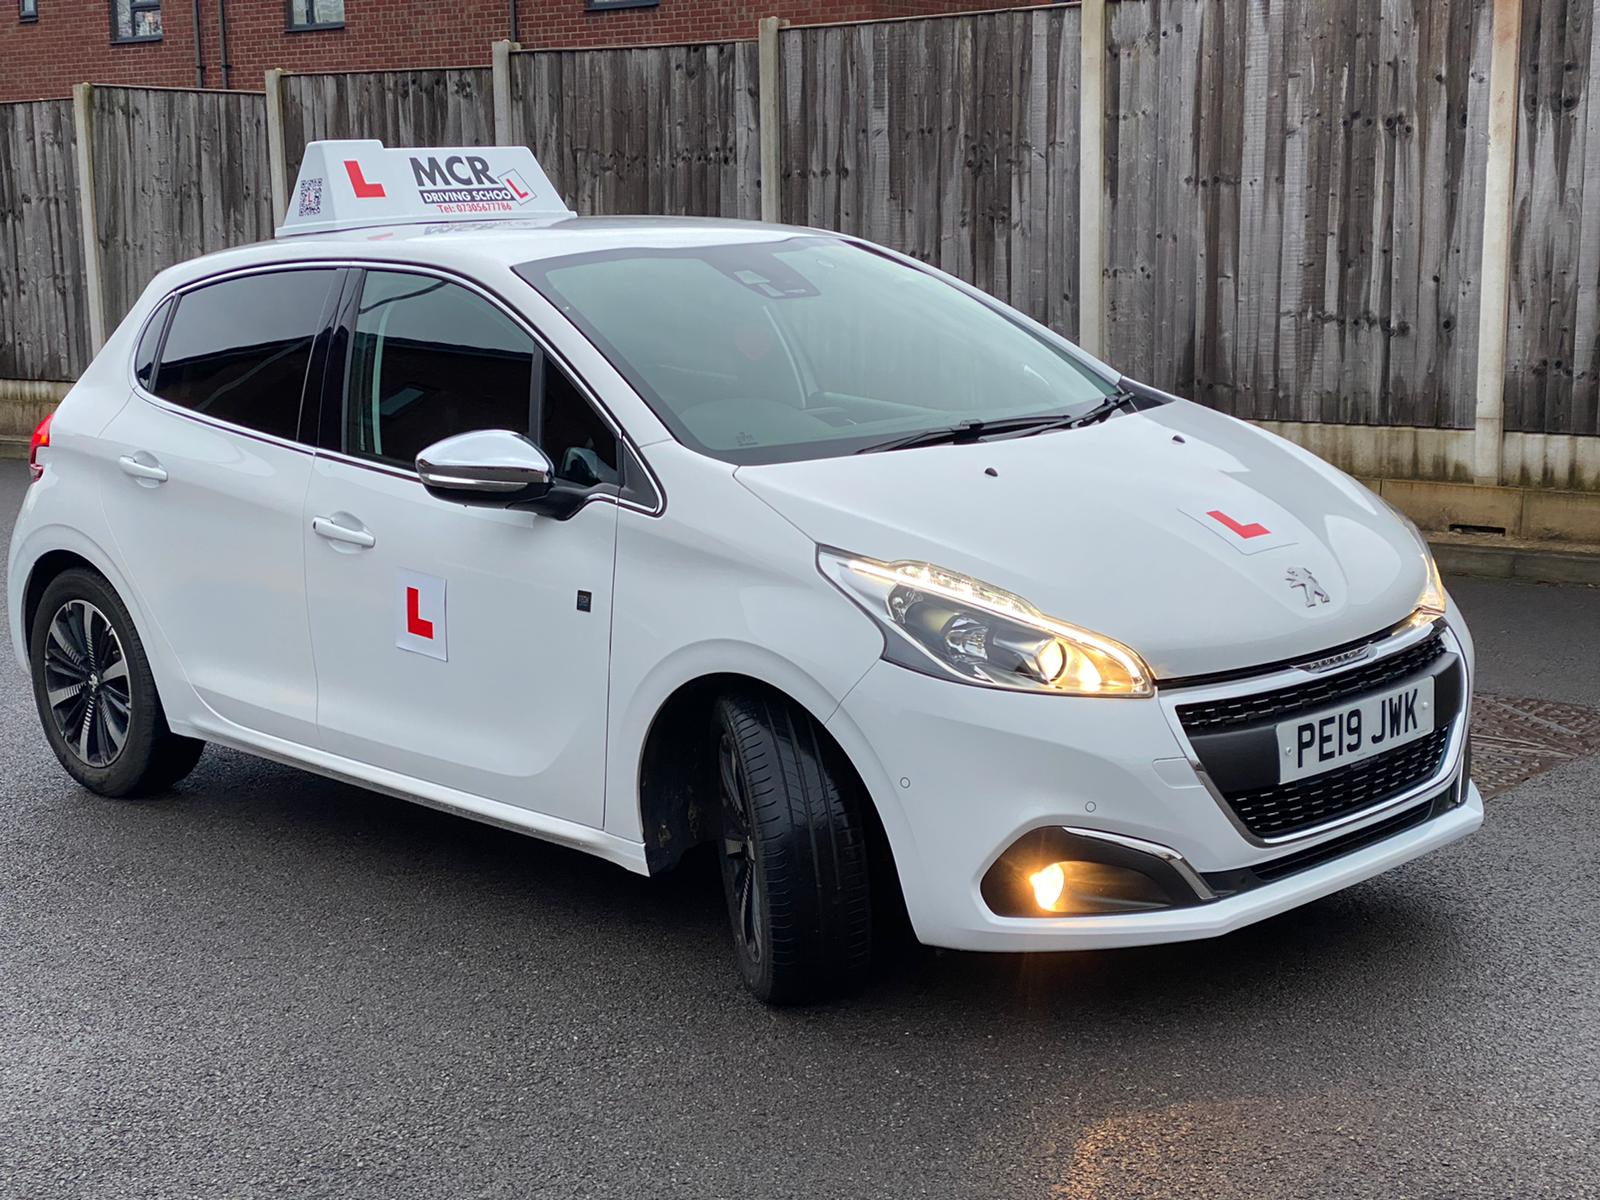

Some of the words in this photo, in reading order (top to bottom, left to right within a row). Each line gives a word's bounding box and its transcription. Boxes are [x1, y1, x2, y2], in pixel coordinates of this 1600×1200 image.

[343, 160, 386, 198] L
[409, 155, 499, 187] MCR
[422, 190, 471, 203] DRIVING
[437, 204, 455, 214] Tel:
[1206, 510, 1272, 539] L
[407, 586, 433, 640] L
[1297, 708, 1363, 768] PE19
[1371, 688, 1418, 744] JWK
